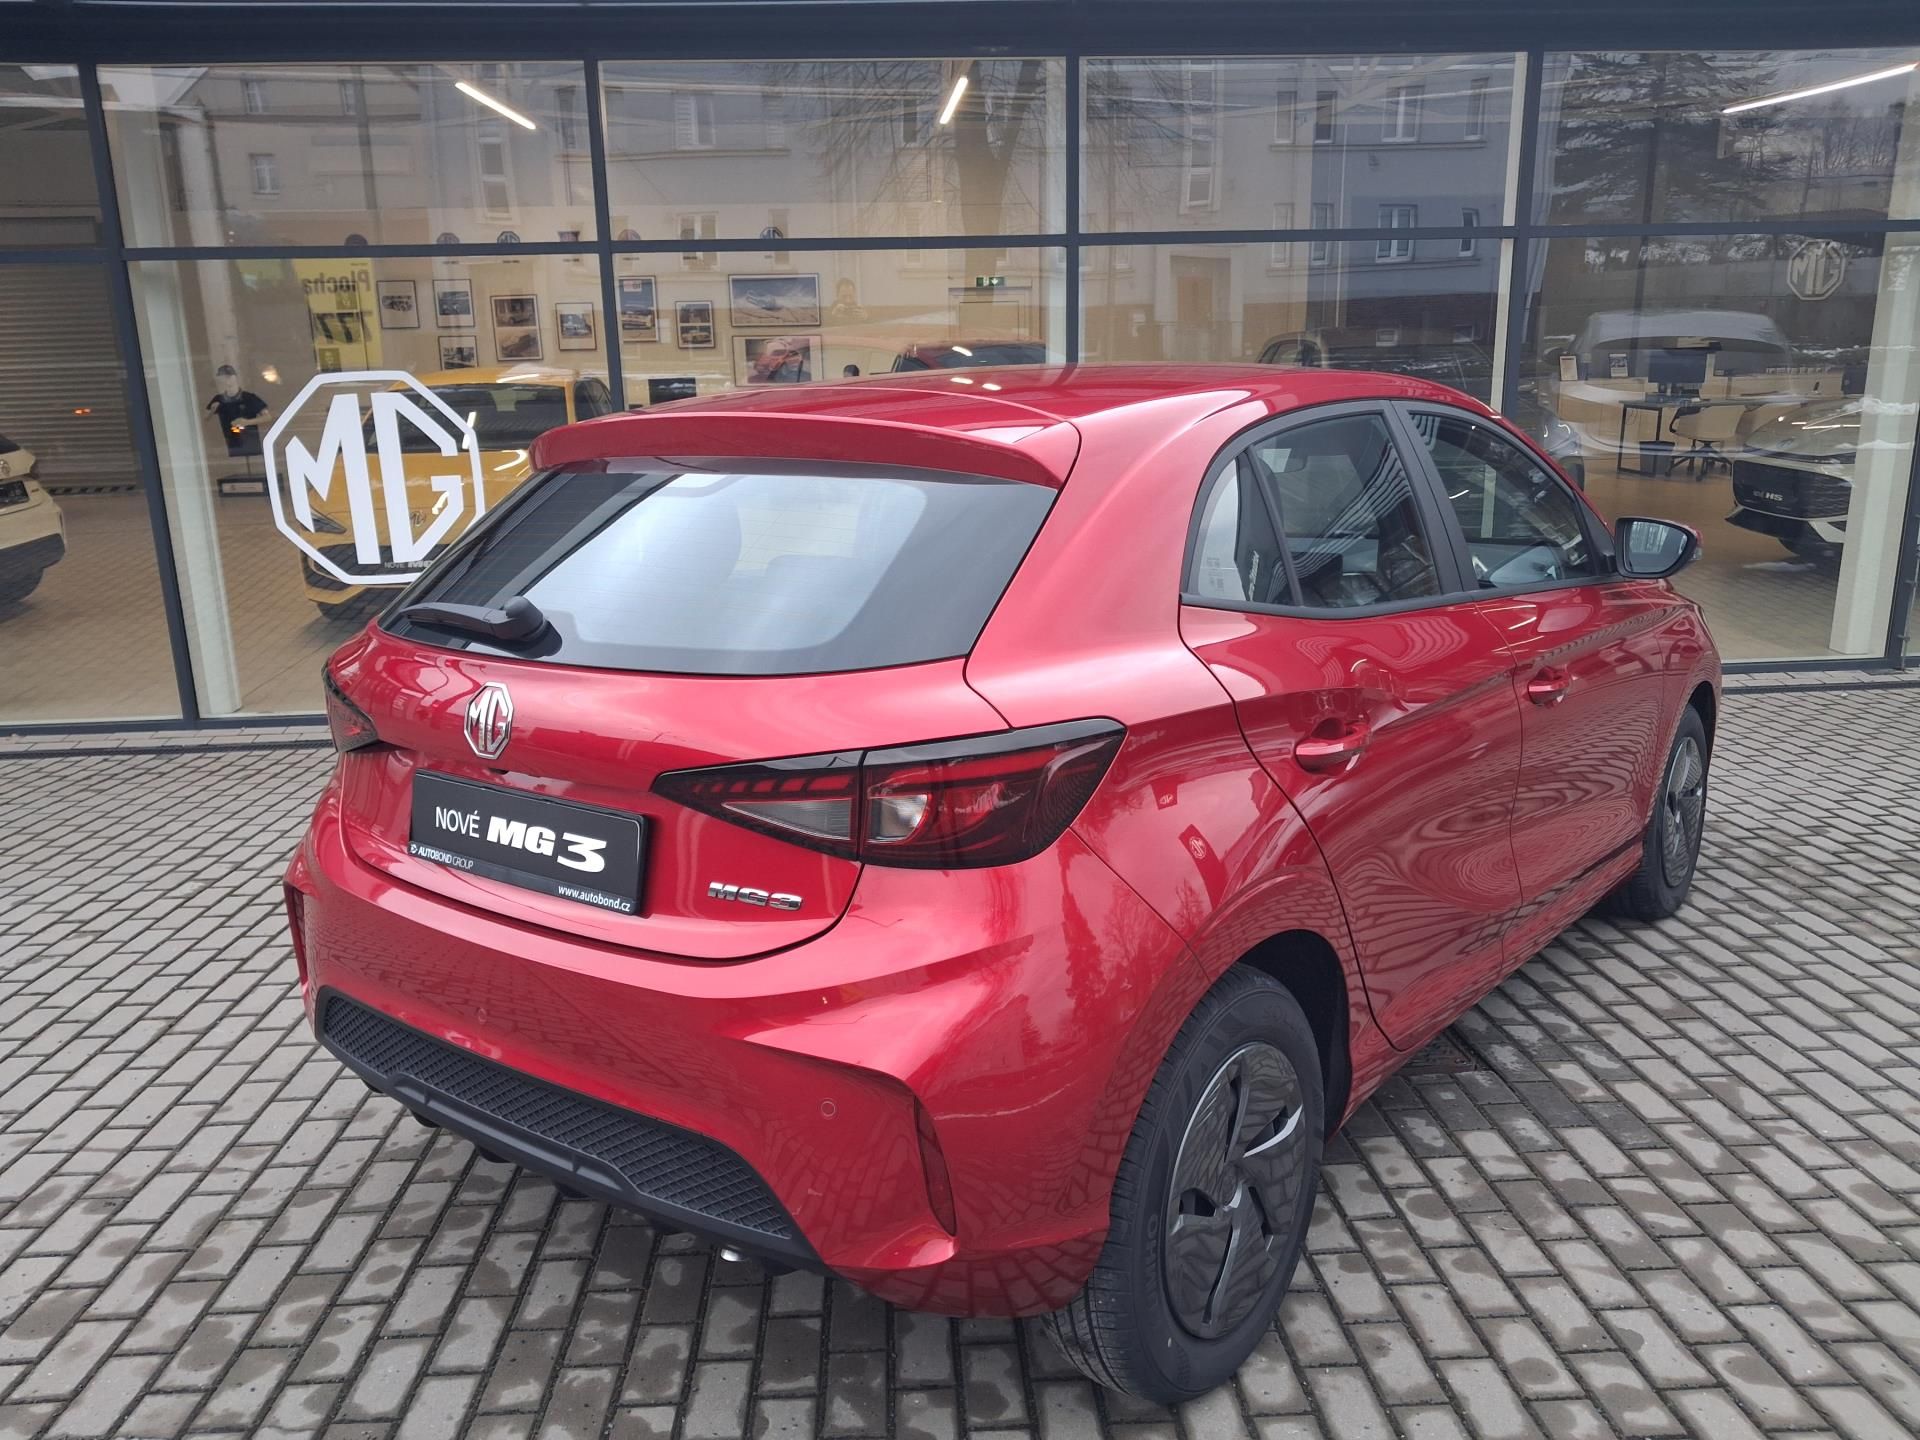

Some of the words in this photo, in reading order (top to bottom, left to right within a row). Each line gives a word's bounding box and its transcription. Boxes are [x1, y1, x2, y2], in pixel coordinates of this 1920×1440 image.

[285, 392, 464, 564] MG
[468, 687, 508, 751] MG
[435, 806, 481, 838] NOVÉ
[418, 845, 452, 864] AUTOBOND
[452, 855, 474, 870] GROUP
[558, 885, 631, 912] www.autobond.cz
[707, 881, 803, 911] MG3
